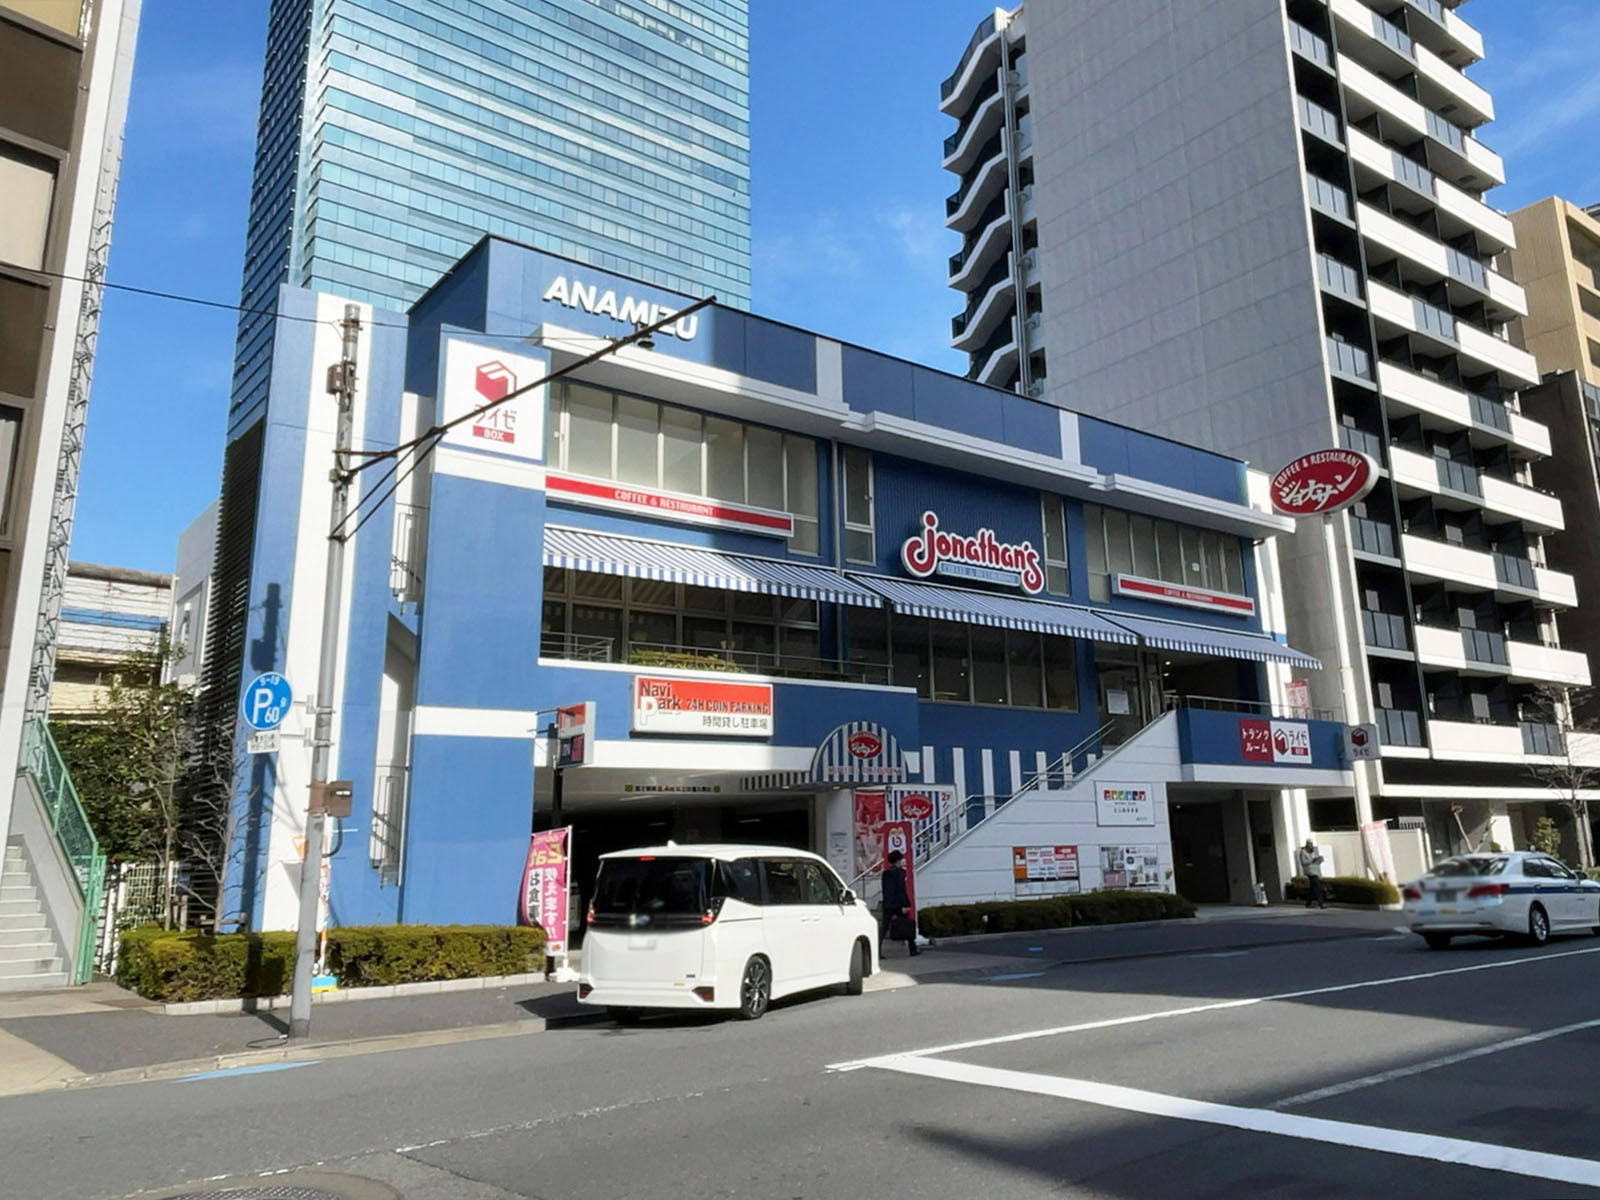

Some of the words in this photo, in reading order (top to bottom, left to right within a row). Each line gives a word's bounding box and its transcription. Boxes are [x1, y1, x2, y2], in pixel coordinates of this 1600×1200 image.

[543, 276, 698, 340] ANAMIZU
[484, 429, 504, 441] BOX
[1274, 461, 1301, 488] COFFEE
[1302, 458, 1309, 468] &
[1310, 452, 1362, 468] RESTAURANT
[614, 489, 648, 505] COFFEE
[650, 496, 658, 506] &
[660, 498, 714, 516] RESTAURANT
[640, 682, 672, 698] Navi
[253, 688, 273, 724] P
[641, 696, 682, 725] Park
[686, 700, 704, 711] 24H
[706, 700, 728, 712] COIN
[730, 701, 769, 714] PARKING
[264, 706, 280, 723] 60
[702, 715, 768, 729] 時間貸し駐車場
[1242, 728, 1269, 740] トランク
[1288, 730, 1307, 746] ライゼ
[1246, 743, 1268, 753] ルーム
